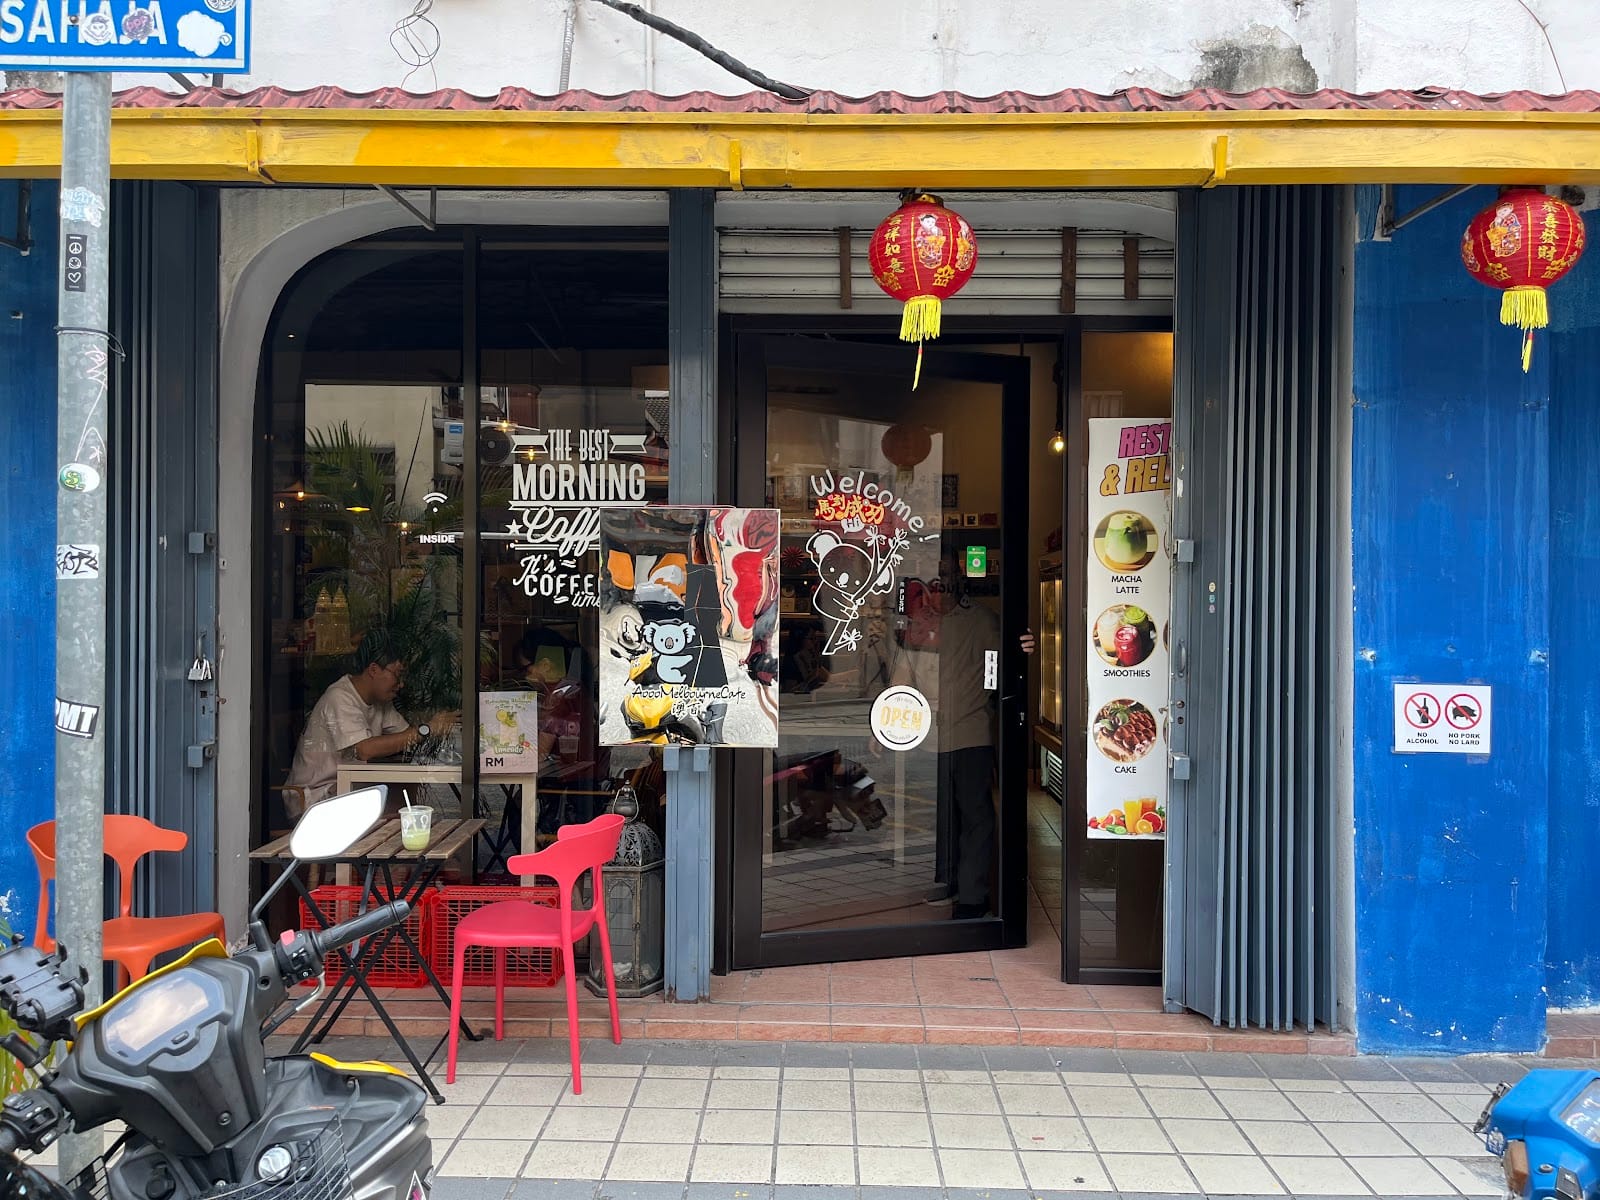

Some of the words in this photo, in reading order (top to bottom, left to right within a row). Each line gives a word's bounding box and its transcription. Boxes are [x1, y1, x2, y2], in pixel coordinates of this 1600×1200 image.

[548, 429, 572, 461] THE
[579, 429, 609, 461] BEST
[513, 463, 645, 501] MORNING
[1100, 463, 1120, 496] &
[846, 515, 860, 528] Hi
[420, 534, 456, 544] INSIDE
[512, 554, 556, 586] It's
[524, 574, 601, 596] COFFE
[1111, 575, 1142, 583] MACHA
[1115, 586, 1140, 594] LATTE
[1103, 669, 1150, 678] SMOOTHIES
[881, 706, 923, 730] OPEN
[485, 757, 504, 767] RM
[1114, 766, 1137, 774] CAKE
